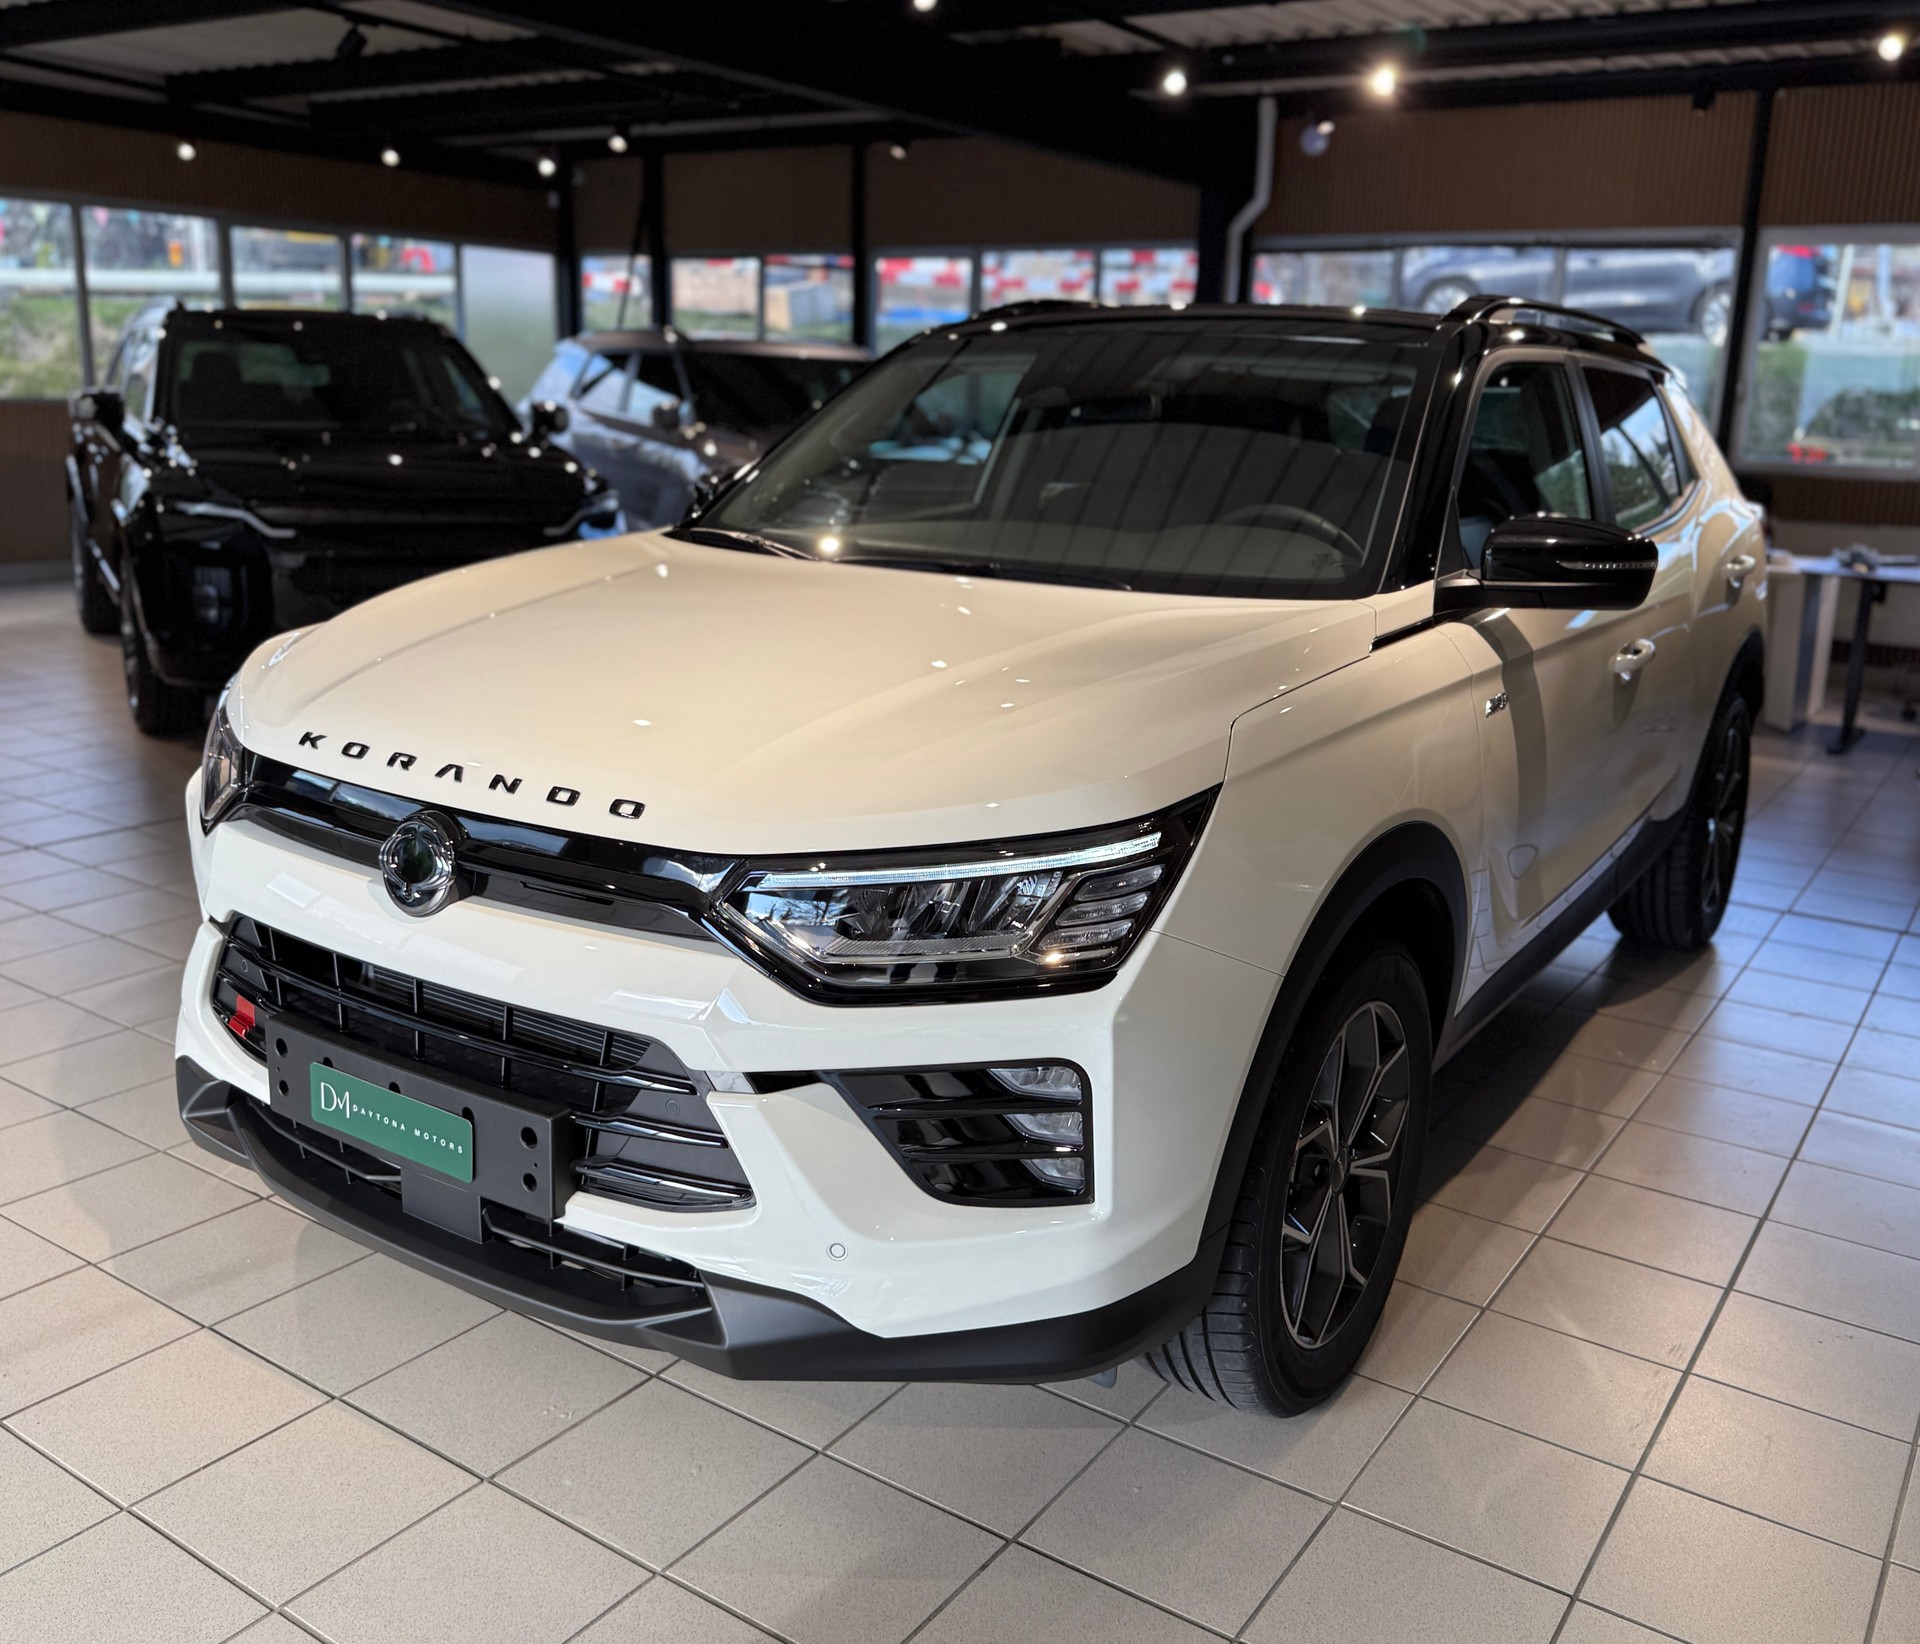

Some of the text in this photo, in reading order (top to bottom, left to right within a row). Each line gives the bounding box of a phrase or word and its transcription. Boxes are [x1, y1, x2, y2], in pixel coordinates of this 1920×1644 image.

[299, 731, 645, 820] KORANDO
[320, 1081, 350, 1119] DM
[352, 1104, 463, 1154] DAYTONA MOTORS
